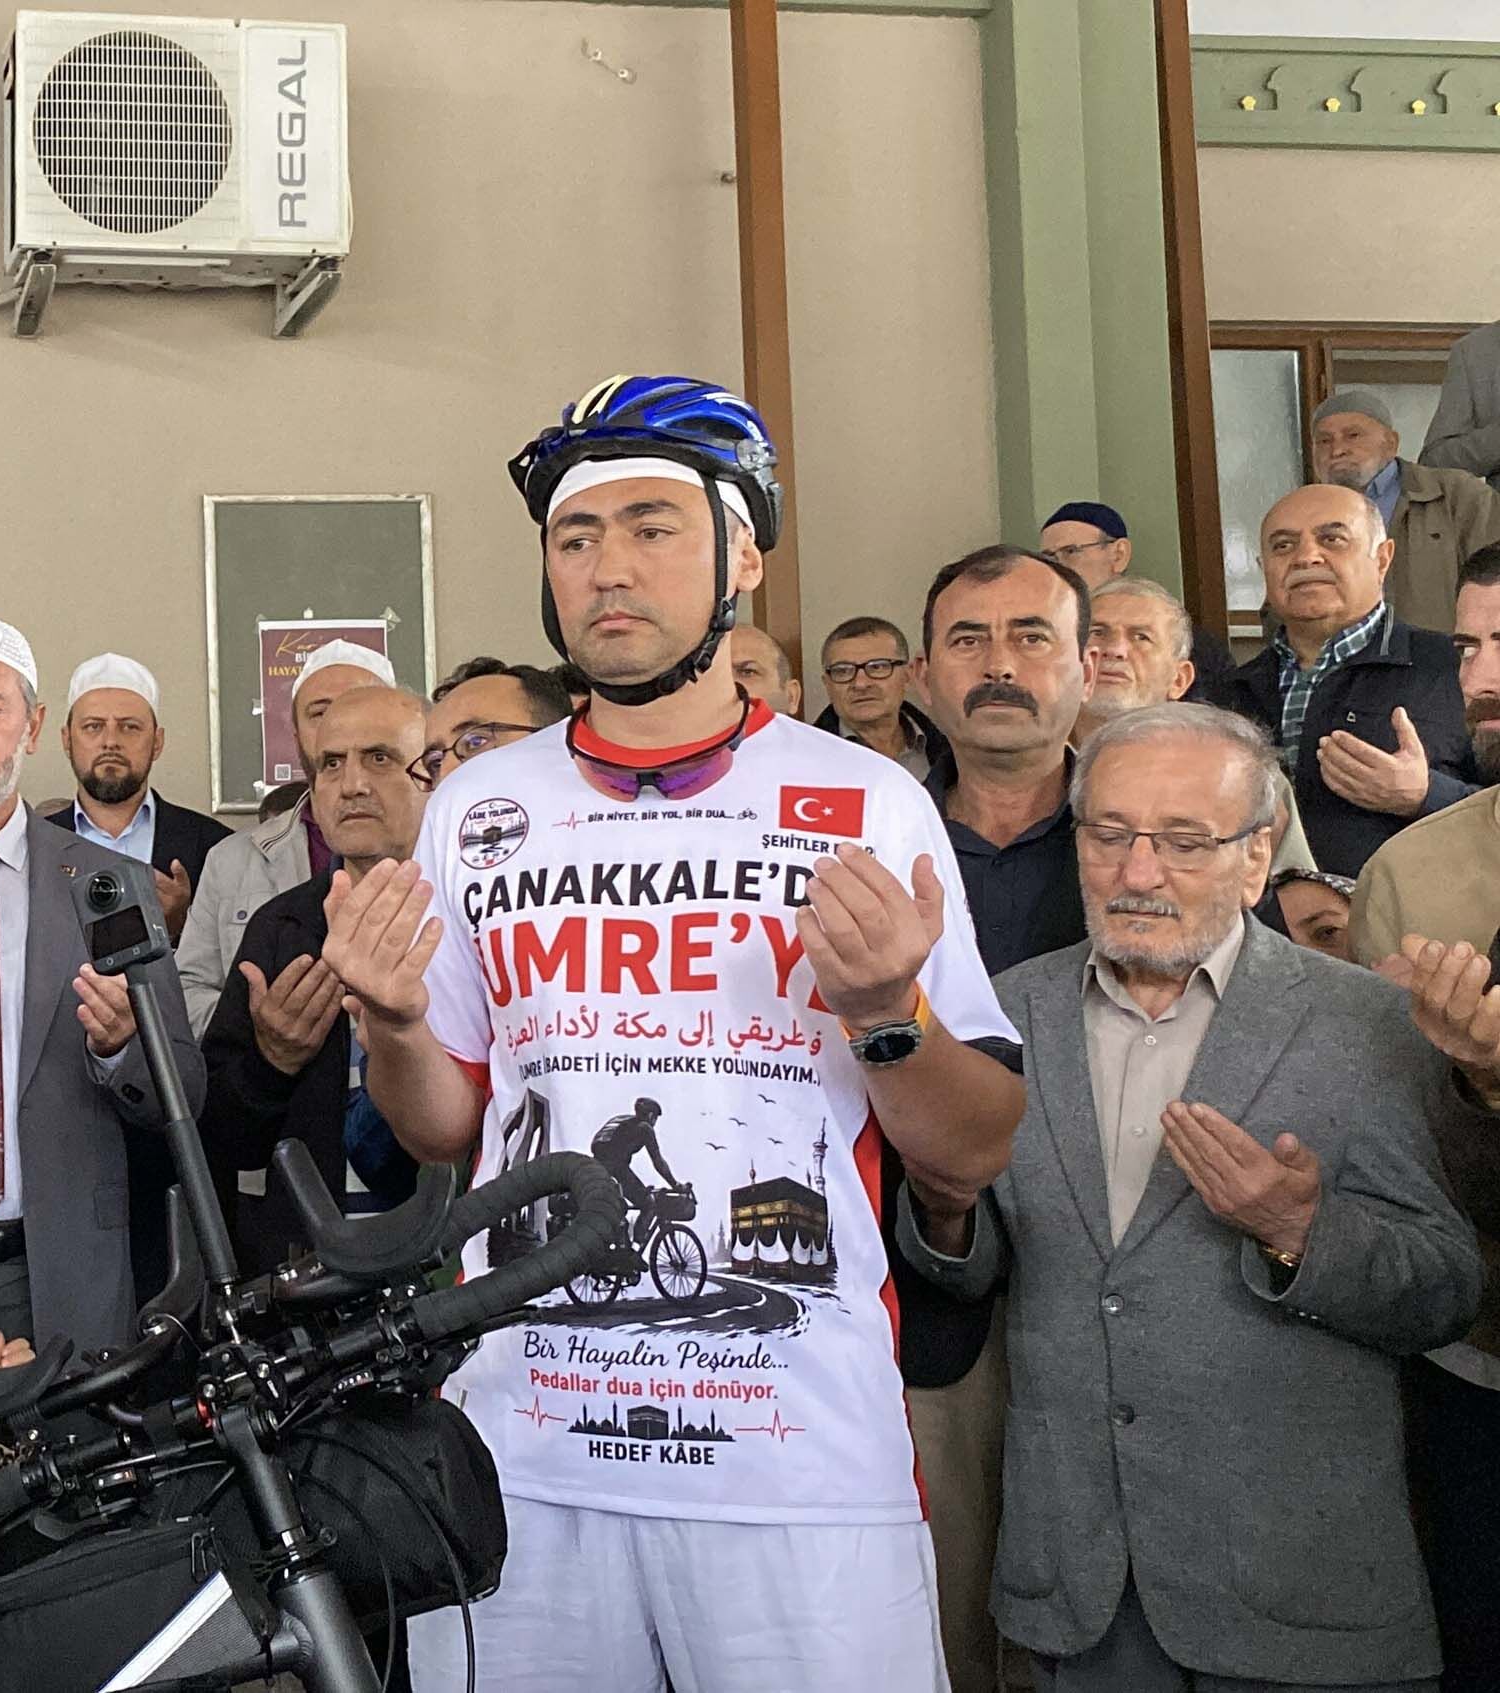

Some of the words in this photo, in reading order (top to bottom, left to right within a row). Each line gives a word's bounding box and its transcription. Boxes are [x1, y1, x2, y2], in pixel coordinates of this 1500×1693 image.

[277, 40, 307, 227] REGAL
[295, 650, 307, 663] Bİ
[587, 811, 604, 823] BİR
[606, 811, 638, 821] NİYET,
[641, 809, 658, 820] BİR
[661, 811, 682, 819] YOL,
[685, 808, 702, 818] BİR
[762, 833, 829, 854] ŞEHİTLER
[464, 860, 816, 933] ÇANAKKALE'D
[473, 912, 835, 1014] UMRE'Y
[544, 1004, 600, 1039] لأداء
[613, 1010, 667, 1039] مكة
[678, 1009, 715, 1048] إلى
[543, 1052, 599, 1074] İBADETİ
[605, 1052, 641, 1076] İÇİN
[647, 1056, 706, 1074] MEKKE
[524, 1331, 559, 1359] Bir
[568, 1335, 668, 1372] Hayalin
[677, 1340, 789, 1373] Peşinde...
[530, 1369, 600, 1393] Pedallar
[607, 1376, 643, 1396] dua
[650, 1378, 685, 1403] için
[693, 1379, 779, 1404] dönüyor.
[589, 1440, 652, 1463] HEDEF
[660, 1442, 715, 1465] KÂBE
